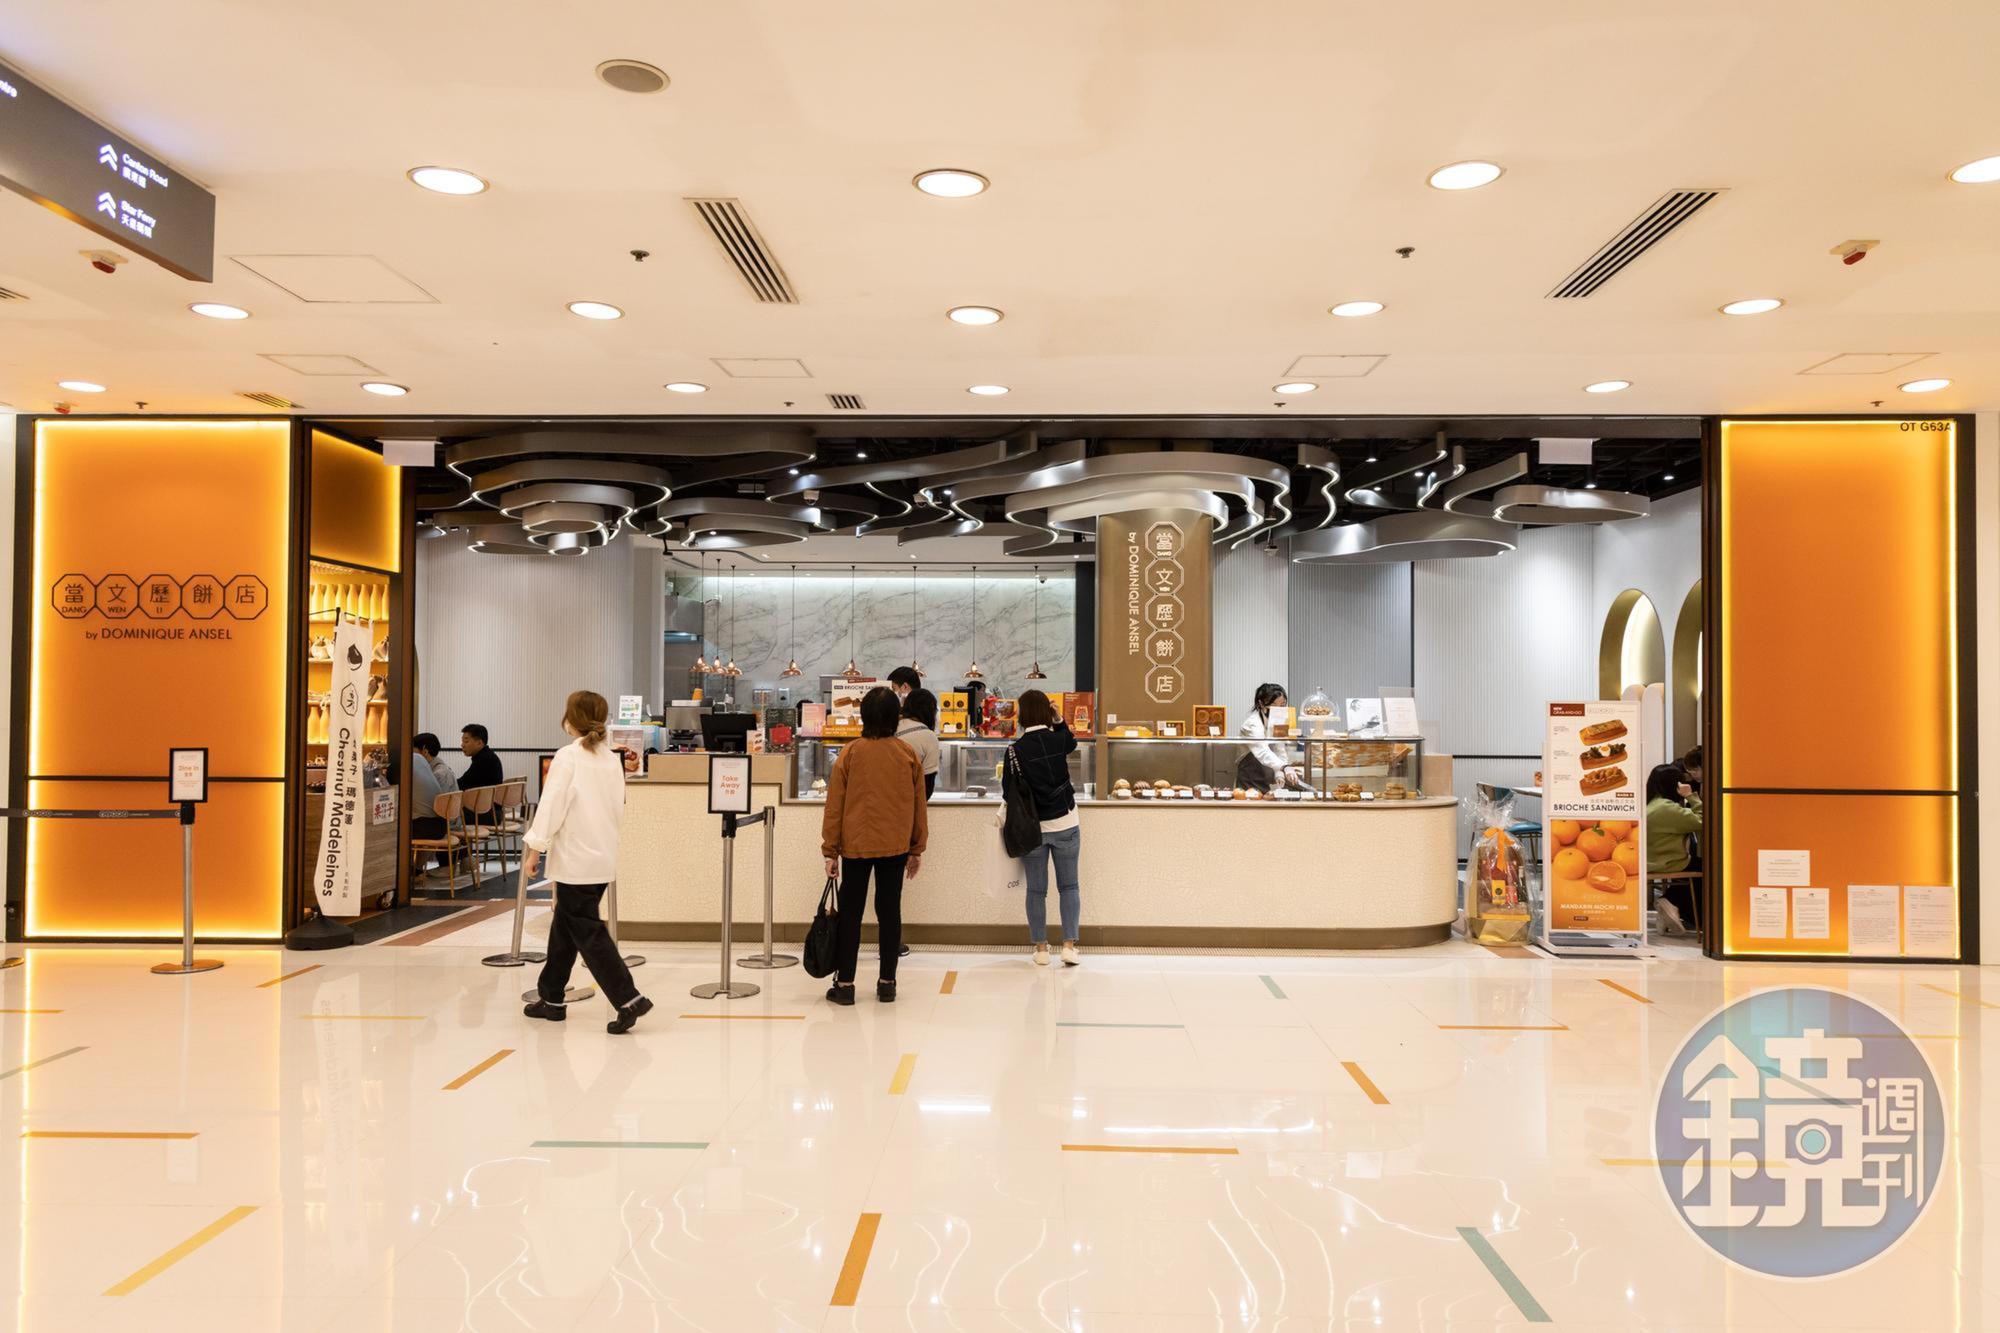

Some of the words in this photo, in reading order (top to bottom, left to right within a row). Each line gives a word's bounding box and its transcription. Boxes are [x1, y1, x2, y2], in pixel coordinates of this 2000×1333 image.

[1900, 422, 1916, 432] OT
[1920, 422, 1952, 432] G63A
[1128, 532, 1137, 543] by
[1128, 545, 1139, 615] DOMINIQUE
[85, 630, 98, 640] by
[101, 628, 185, 640] DOMINIQUE
[188, 628, 232, 640] ANSEL
[1128, 617, 1139, 655] ANSEL
[334, 727, 351, 798] Chestnut
[1591, 804, 1635, 812] SANDWICH
[322, 801, 344, 896] Madeleines
